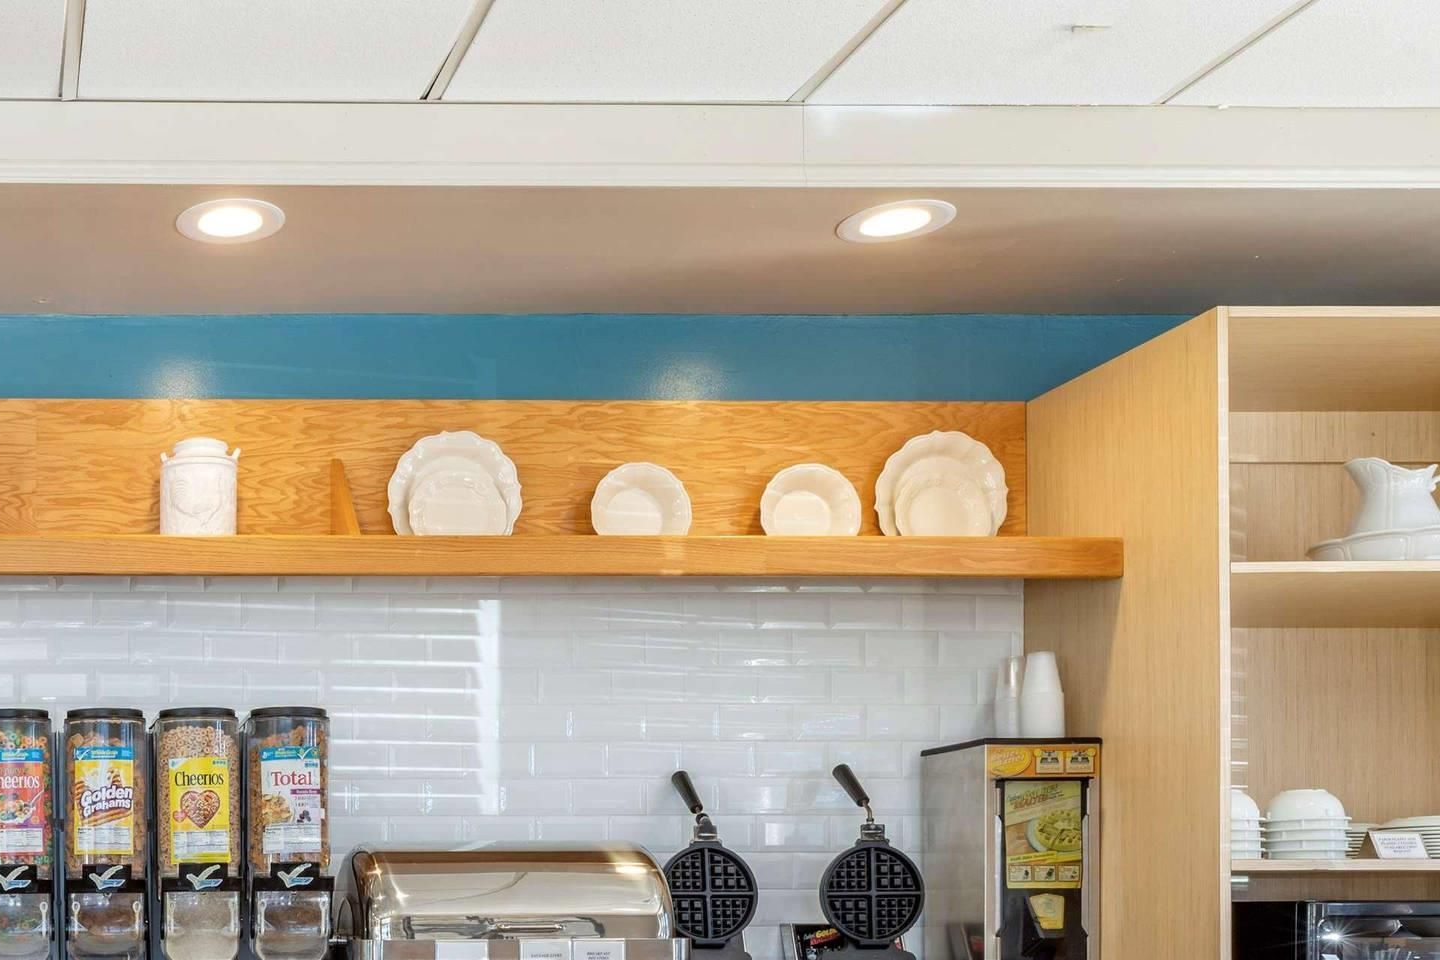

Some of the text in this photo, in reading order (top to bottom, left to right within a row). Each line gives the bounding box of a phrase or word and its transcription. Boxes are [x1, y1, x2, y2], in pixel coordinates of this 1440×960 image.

[174, 771, 224, 786] Cheerios
[270, 771, 313, 787] Total
[80, 785, 133, 807] Golden
[83, 799, 131, 818] Grahams
